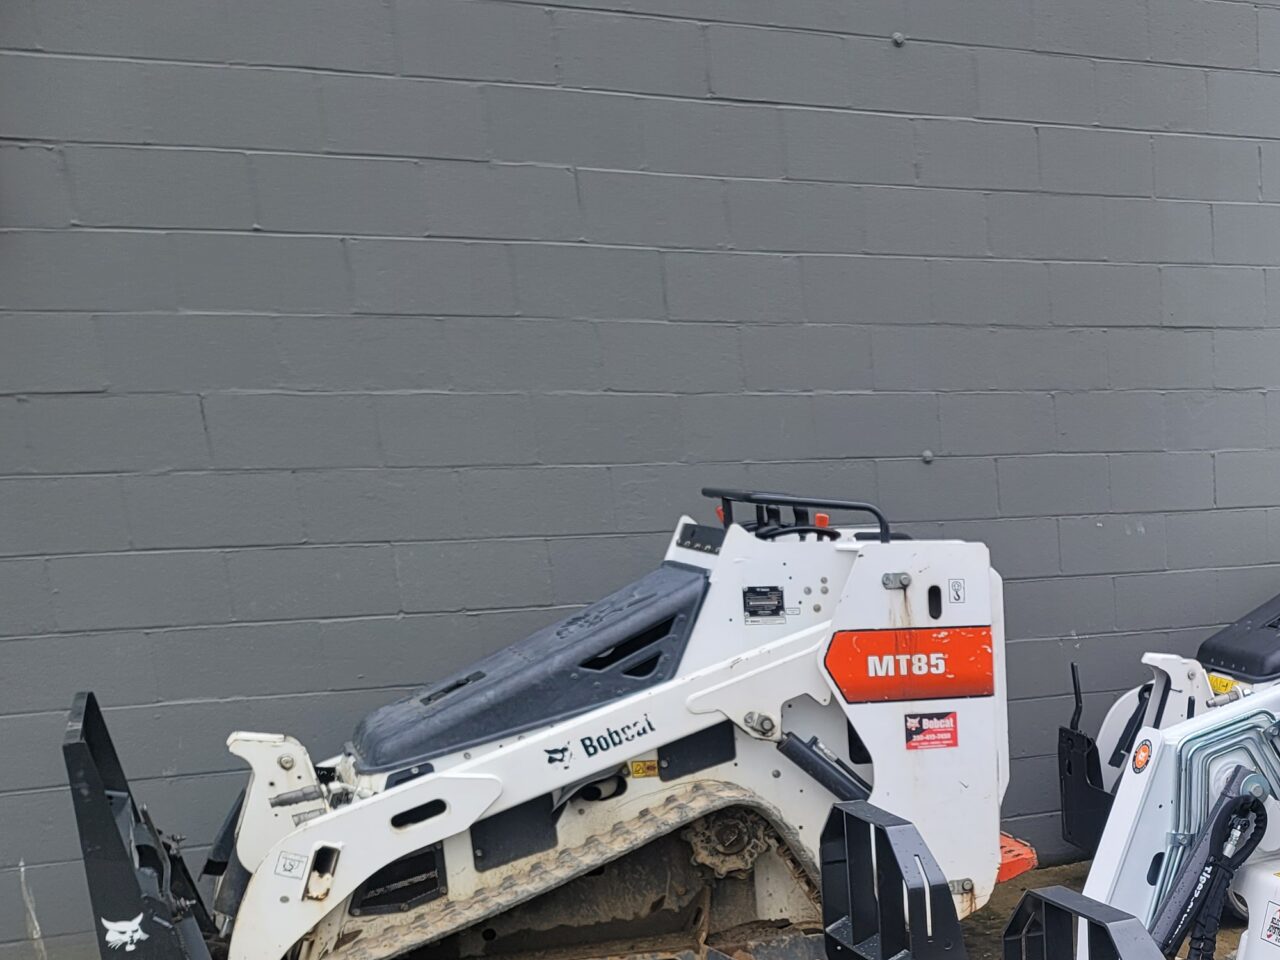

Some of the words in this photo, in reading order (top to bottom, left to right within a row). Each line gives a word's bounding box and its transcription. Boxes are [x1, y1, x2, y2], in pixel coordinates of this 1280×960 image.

[867, 652, 946, 677] MT85
[922, 716, 954, 729] Bobcat
[580, 713, 656, 758] Bobcat
